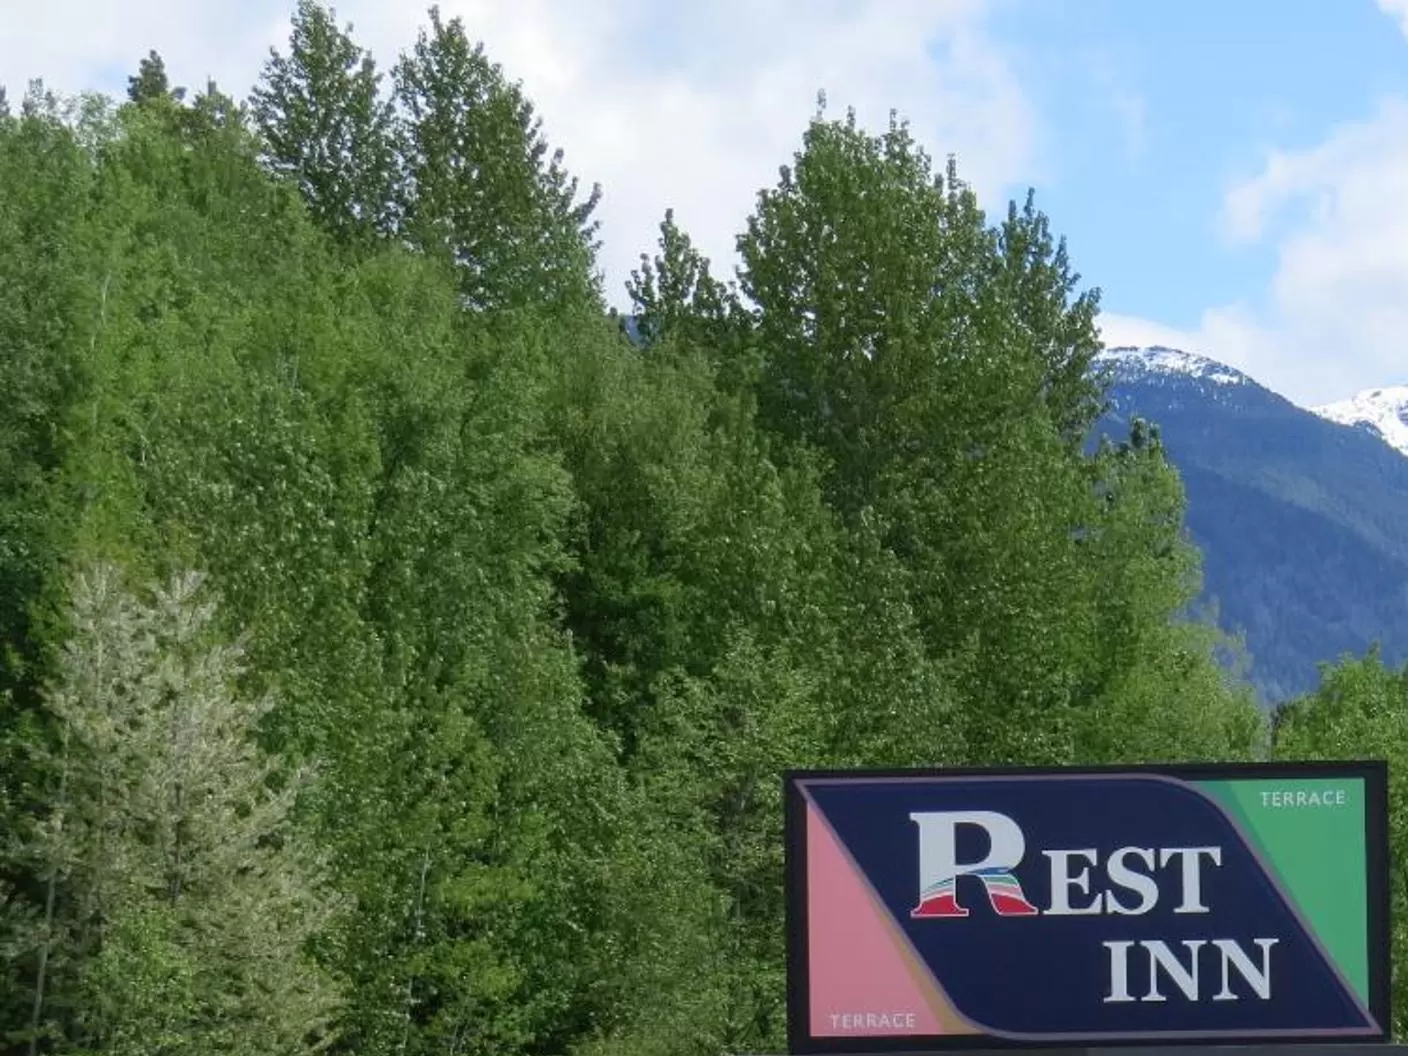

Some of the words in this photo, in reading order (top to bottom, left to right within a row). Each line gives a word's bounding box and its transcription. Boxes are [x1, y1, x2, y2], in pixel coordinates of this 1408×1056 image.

[1260, 790, 1346, 807] TERRACE
[910, 810, 1222, 917] REST
[1104, 938, 1279, 1002] INN
[830, 1013, 916, 1029] TERRACE
